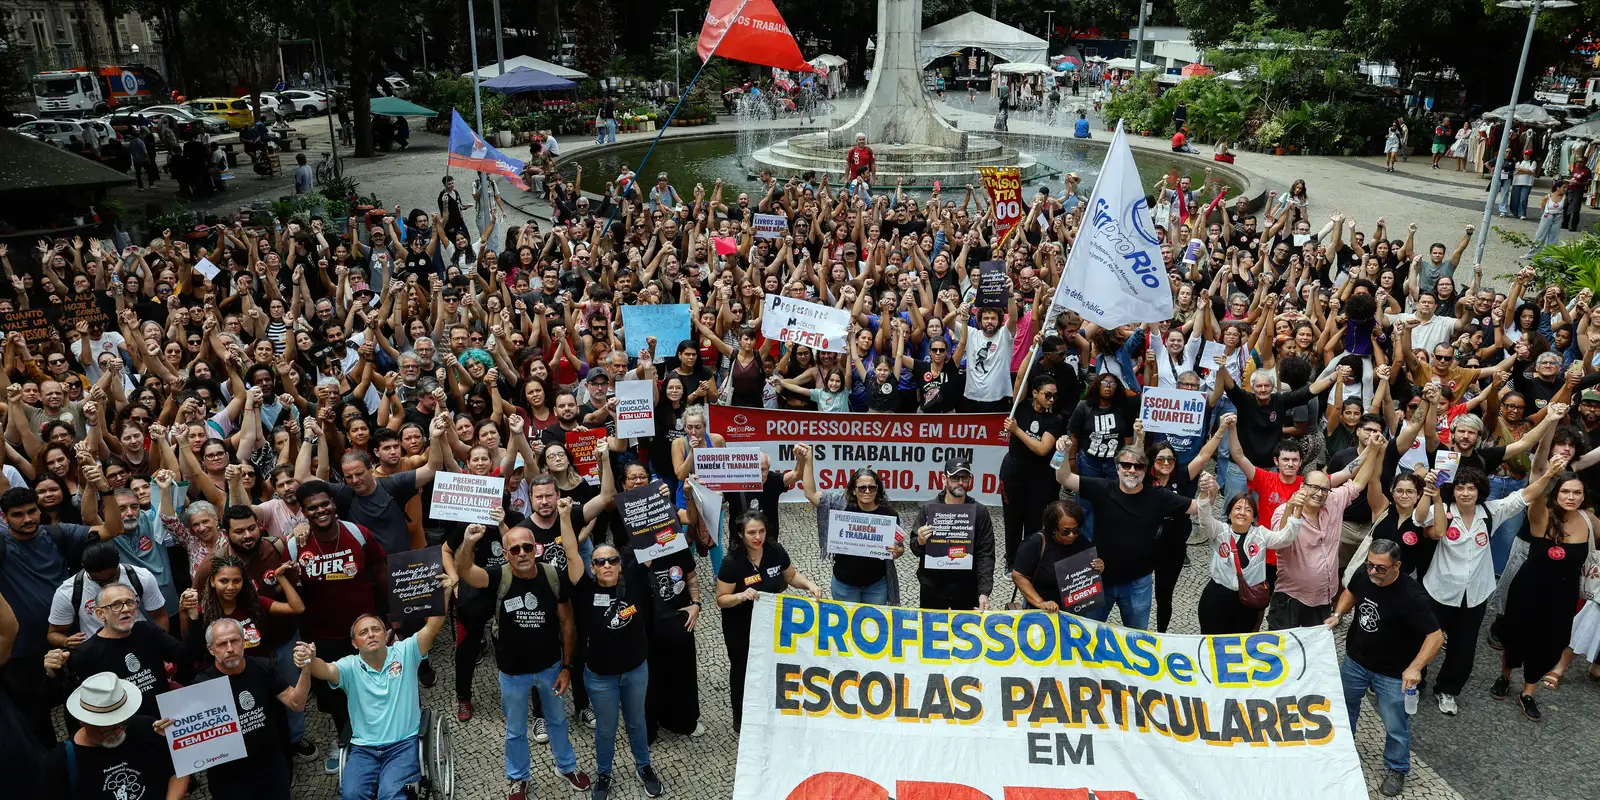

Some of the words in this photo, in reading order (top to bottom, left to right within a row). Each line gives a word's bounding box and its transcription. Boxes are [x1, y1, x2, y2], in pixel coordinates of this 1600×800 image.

[996, 201, 1020, 219] 00
[64, 303, 86, 311] HOJE
[5, 310, 44, 321] QUANTO
[4, 320, 28, 330] VALE
[780, 327, 829, 349] RESPEITO
[1144, 397, 1180, 410] ESCOLA
[1183, 398, 1203, 412] NÃO
[1143, 406, 1149, 419] É
[1151, 410, 1194, 424] QUARTEL
[766, 419, 913, 438] PROFESSORES/AS
[919, 423, 942, 440] EM
[949, 424, 987, 440] LUTA
[832, 445, 925, 463] TRABALHO
[932, 448, 973, 464] COM
[697, 462, 721, 470] TAMBÉM
[722, 461, 726, 469] É
[438, 482, 475, 493] RELATÓRIOS
[475, 486, 500, 495] TAMBÉM
[452, 476, 488, 487] PREENCHER
[441, 492, 446, 503] É
[447, 494, 493, 508] TRABALHO!
[624, 497, 647, 508] Planejar
[625, 504, 647, 516] Corrigir
[648, 499, 664, 510] prova
[624, 513, 647, 523] Produzir
[648, 503, 671, 516] material
[631, 519, 647, 528] Fazer
[647, 512, 669, 523] reunião
[839, 528, 844, 538] É
[845, 530, 884, 542] TRABALHO!
[848, 523, 876, 533] TAMBÉM
[392, 567, 429, 577] educação
[395, 571, 436, 586] qualidade
[745, 574, 761, 583] GREVE
[393, 582, 429, 594] condições
[399, 587, 434, 598] trabalho
[1068, 595, 1073, 603] É
[1073, 586, 1097, 600] GREVE
[620, 605, 637, 617] GREVE
[776, 596, 1160, 680] PROFESSORAS
[239, 706, 264, 719] DUCAÇÃO
[775, 663, 982, 725] ESCOLAS
[1000, 676, 1335, 747] PARTICULARES
[173, 712, 204, 727] ONDE
[204, 705, 227, 717] TEM
[172, 714, 233, 738] EDUCAÇÃO,
[242, 722, 265, 734] DIGITAL
[178, 734, 202, 747] TEM
[203, 725, 232, 740] LUTA!
[1027, 733, 1094, 766] EM
[205, 753, 229, 763] SinproRio
